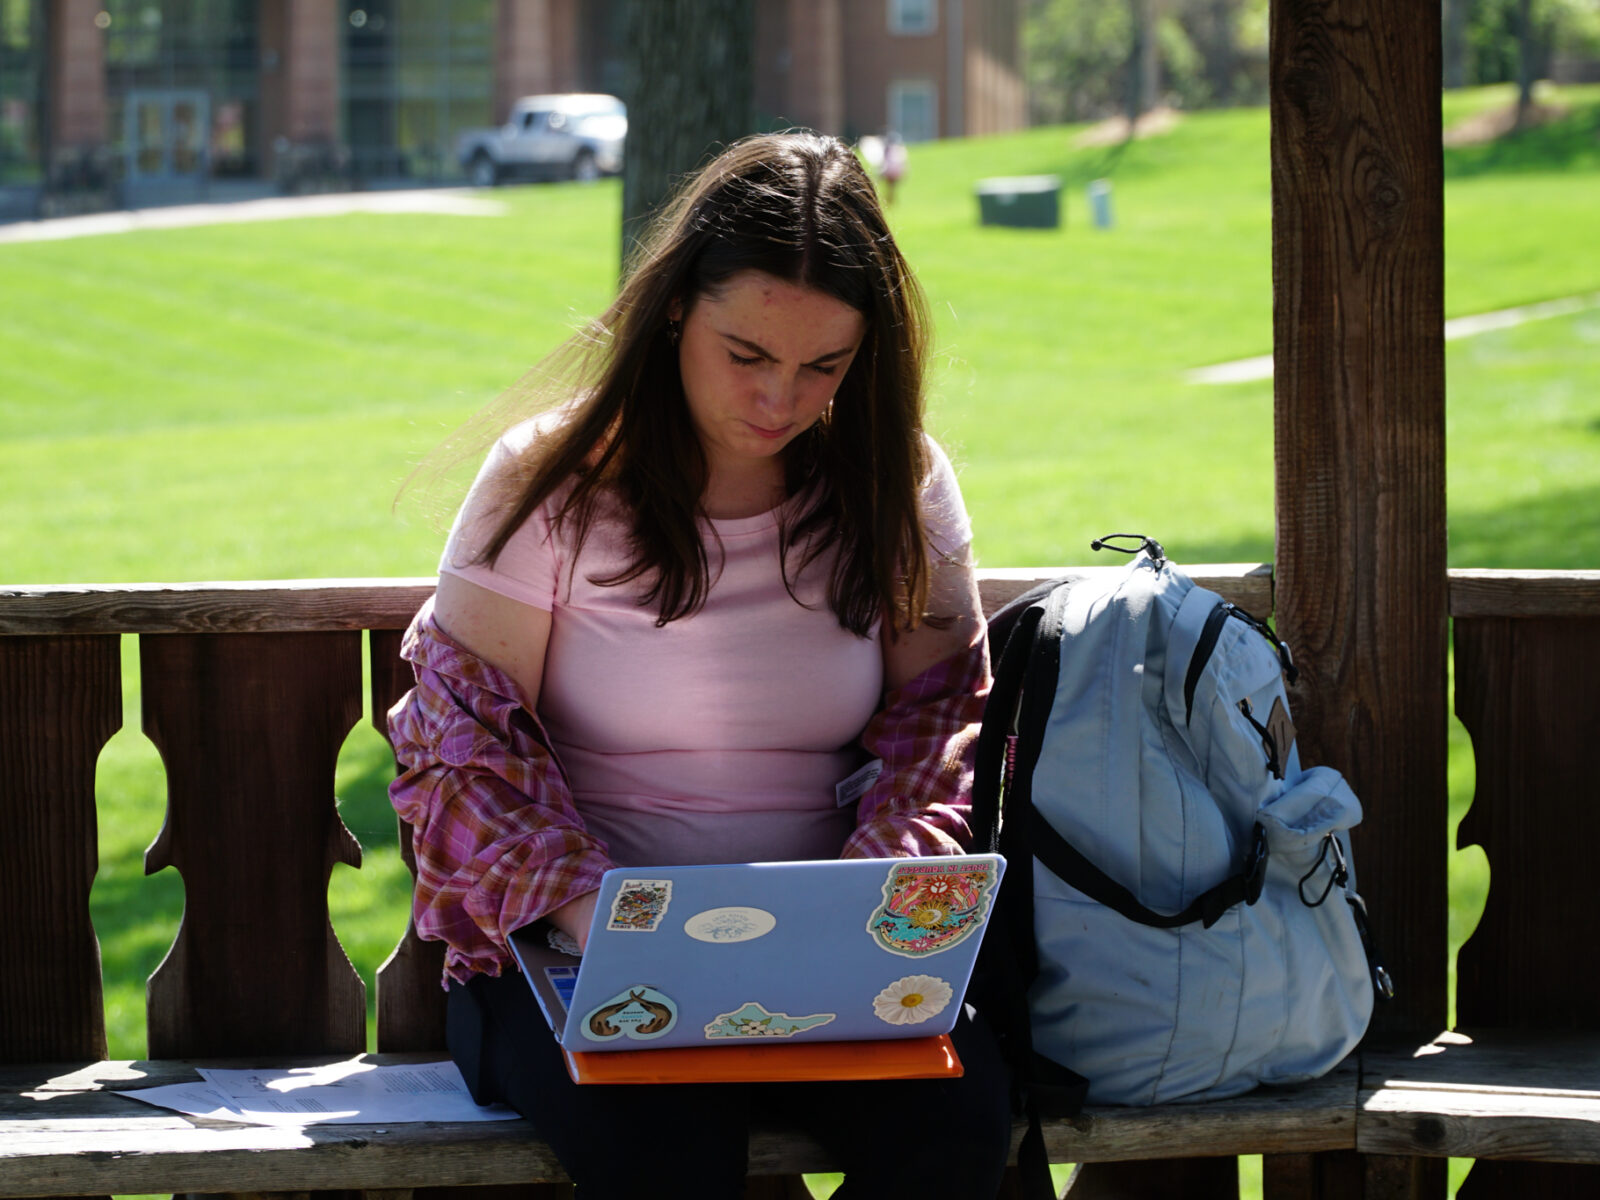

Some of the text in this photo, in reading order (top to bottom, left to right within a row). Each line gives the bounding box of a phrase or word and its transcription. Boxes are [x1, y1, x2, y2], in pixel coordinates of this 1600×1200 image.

[896, 863, 990, 874] TRUST IN YOURSELF
